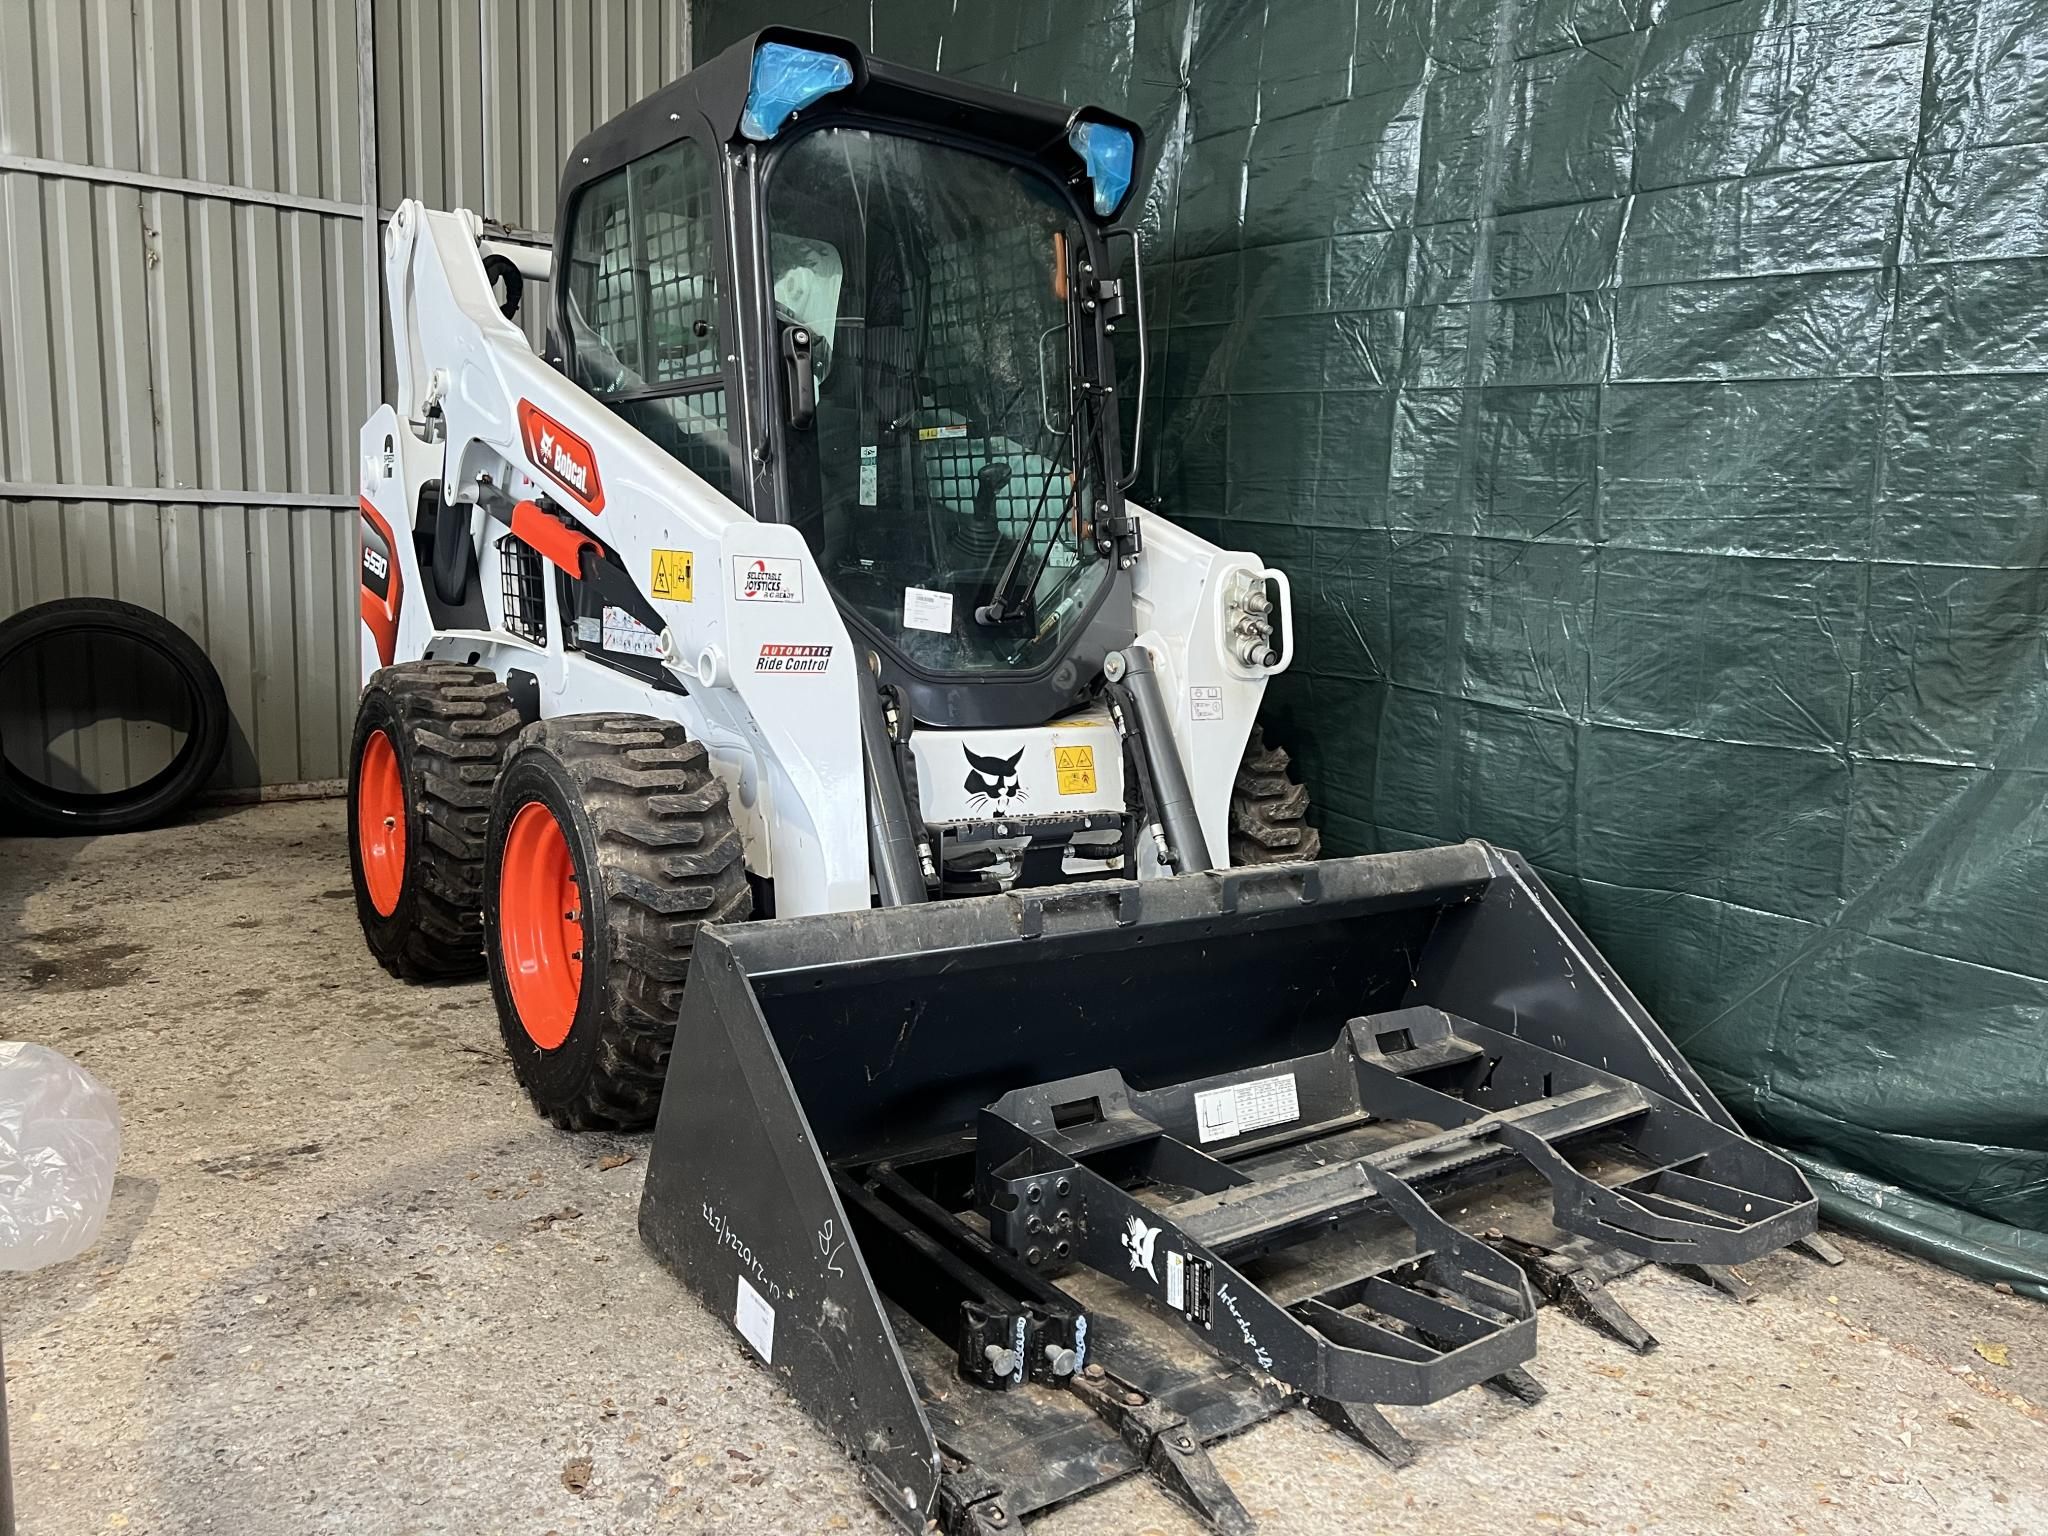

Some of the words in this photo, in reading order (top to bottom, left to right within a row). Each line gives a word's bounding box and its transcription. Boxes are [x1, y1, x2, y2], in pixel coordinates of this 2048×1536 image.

[554, 444, 587, 494] Bobcat
[364, 547, 387, 579] S530
[747, 572, 782, 581] SELECTABLE
[745, 581, 780, 591] JOYSTICKS
[762, 646, 830, 656] AUTOMATIC
[756, 658, 782, 670] Ride
[785, 658, 829, 671] Control
